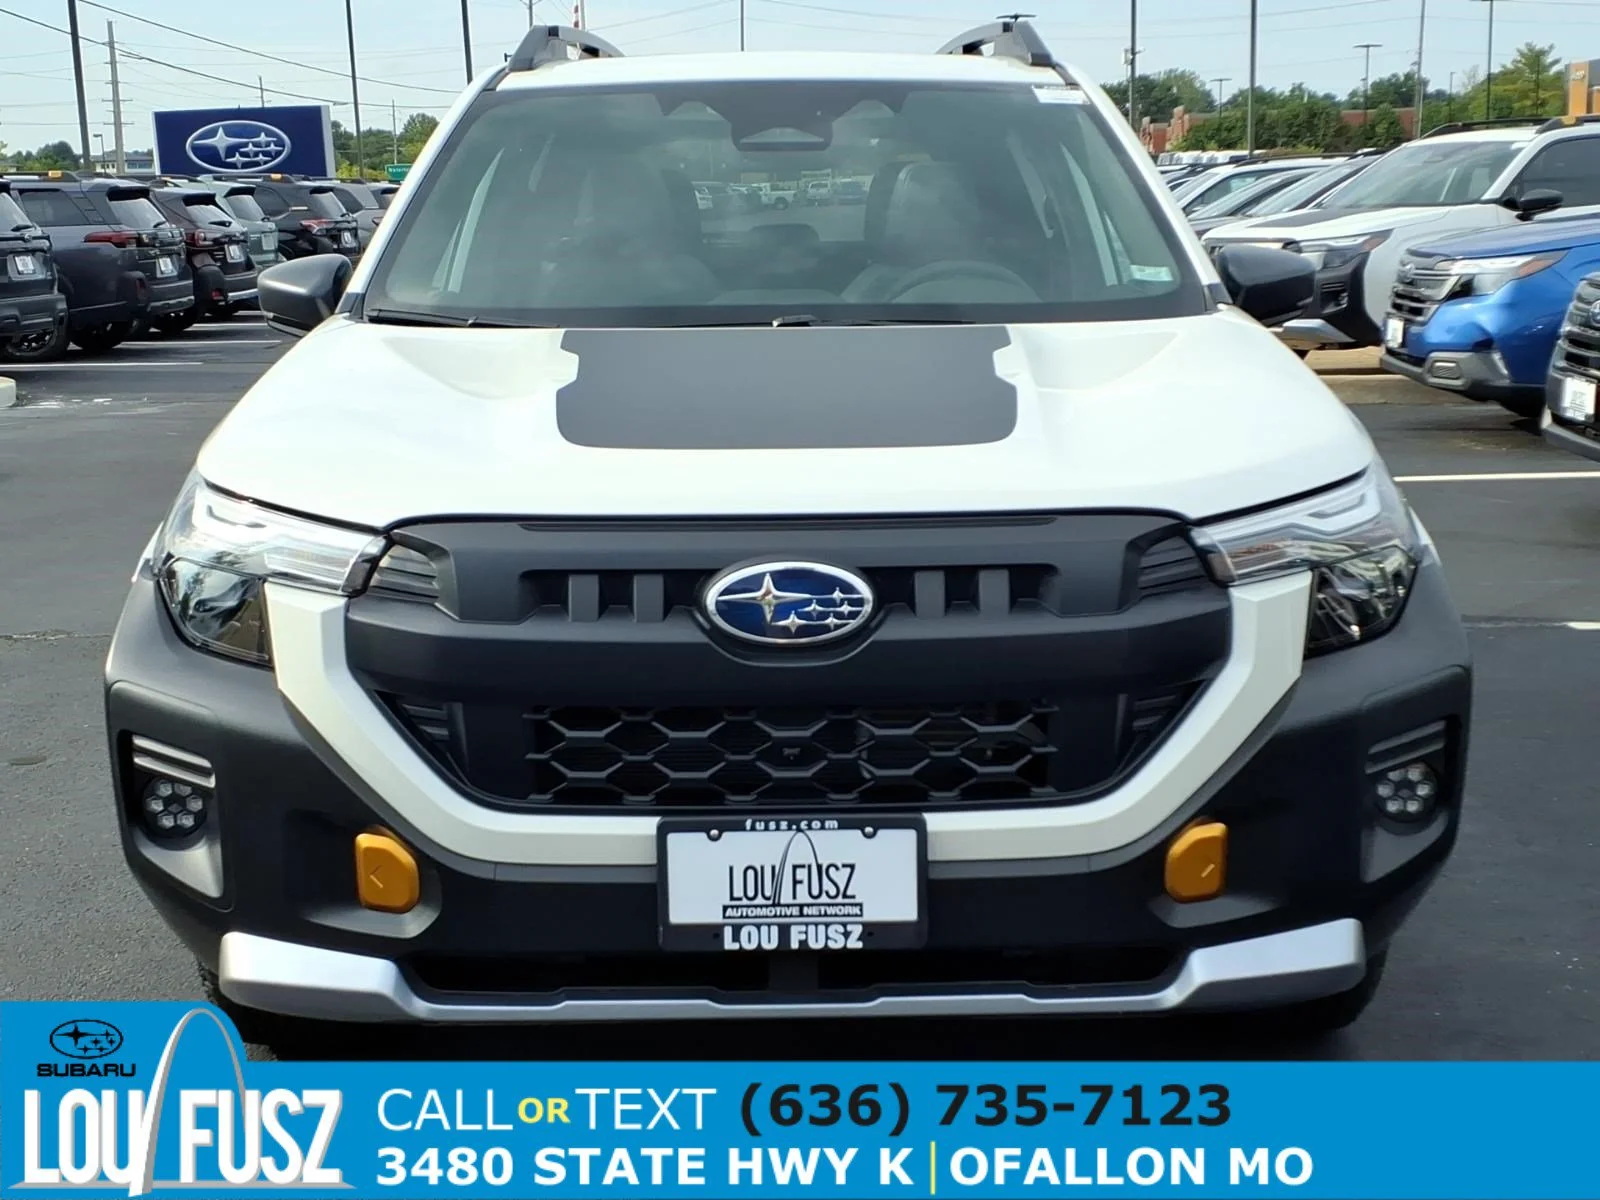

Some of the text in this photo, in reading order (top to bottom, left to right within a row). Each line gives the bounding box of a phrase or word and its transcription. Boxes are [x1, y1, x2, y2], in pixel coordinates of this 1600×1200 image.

[744, 818, 839, 831] fusz.com
[729, 863, 856, 902] LOU FUSZ
[724, 905, 862, 918] AUTOMOTIVE NETWORK
[723, 923, 863, 950] LOU FUSZ
